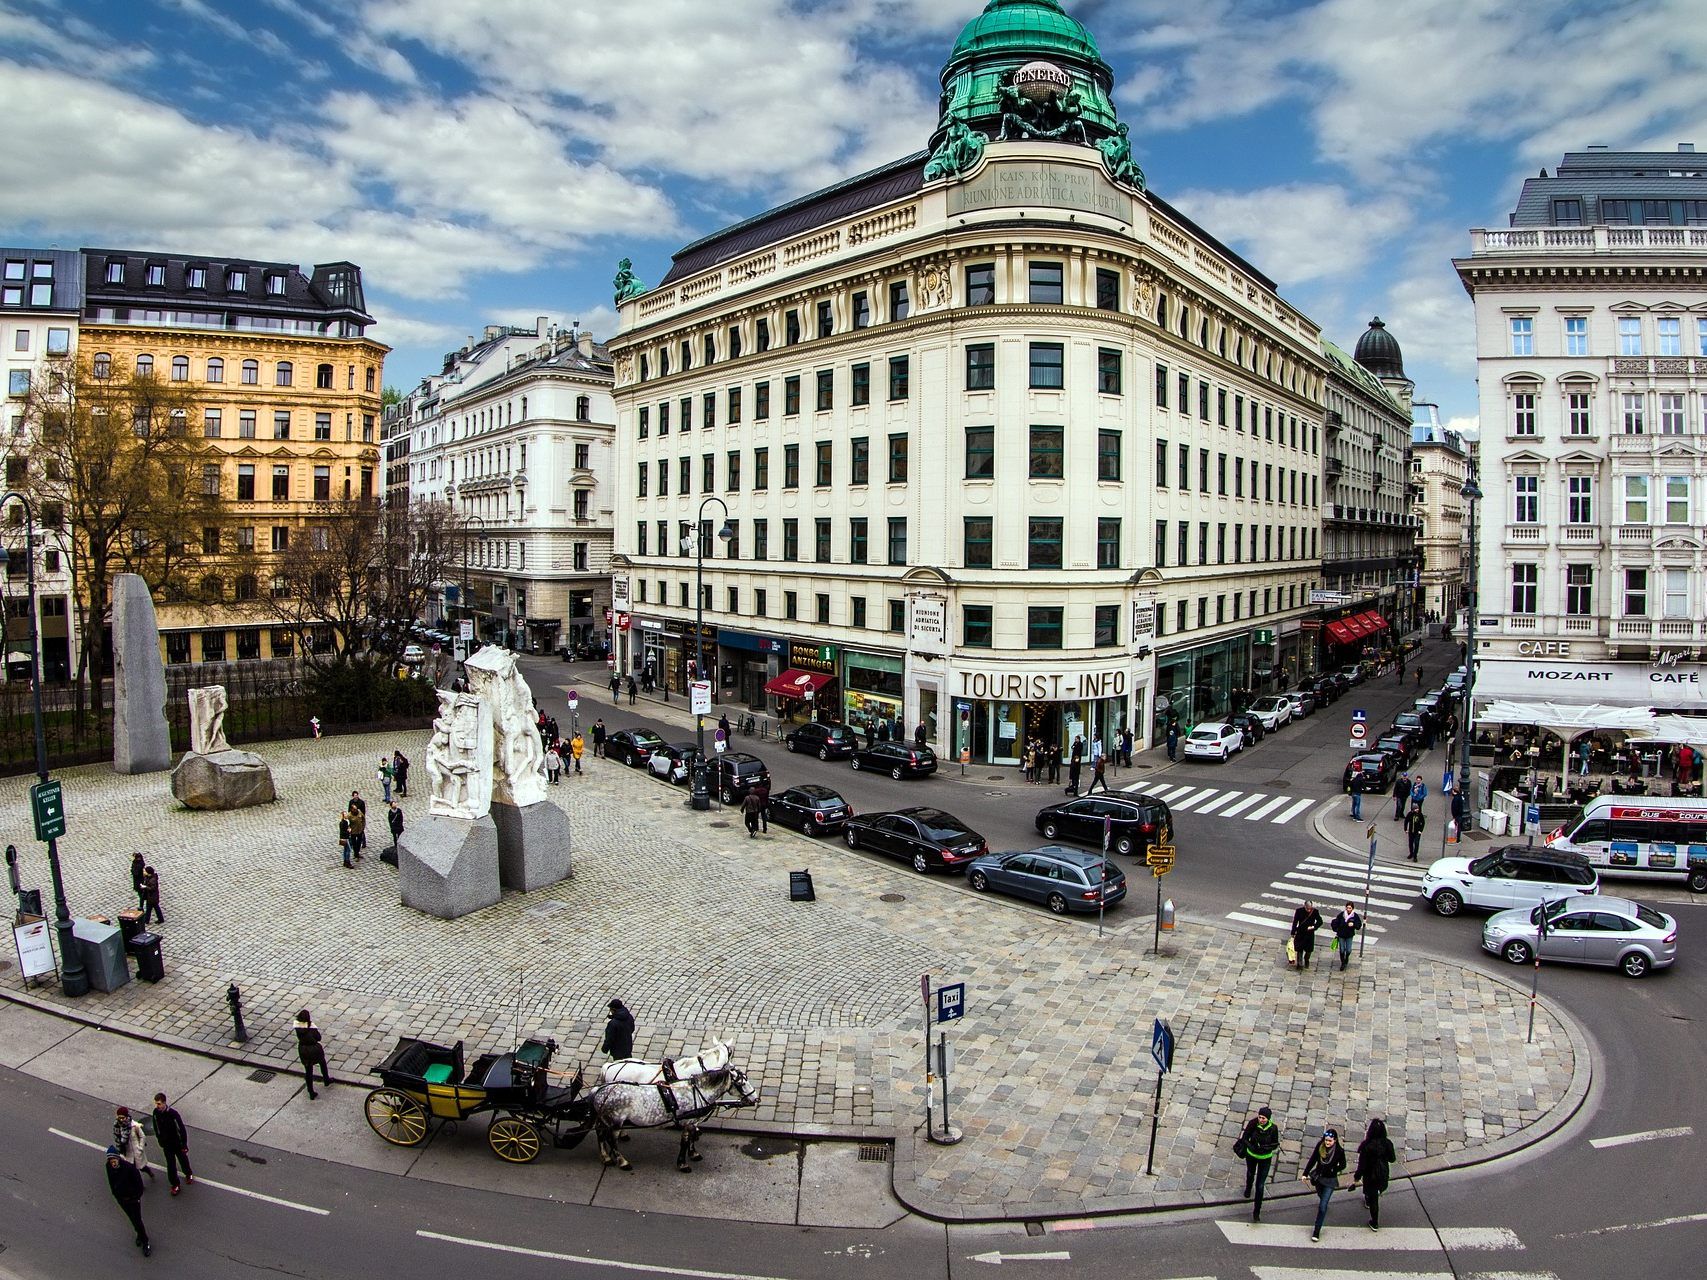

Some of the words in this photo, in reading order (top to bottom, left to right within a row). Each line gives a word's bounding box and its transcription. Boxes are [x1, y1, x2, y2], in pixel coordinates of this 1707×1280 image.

[963, 187, 1014, 206] RIUNIONE
[1017, 186, 1076, 202] ADRIATICA
[916, 609, 939, 617] RIUNIONE
[915, 617, 940, 625] ADRIATICA
[792, 646, 819, 657] BONBO
[1518, 642, 1570, 656] CAFE
[792, 656, 833, 670] ANZINGER
[1653, 646, 1690, 668] Mozart
[1528, 671, 1613, 681] MOZART
[1650, 672, 1699, 683] CAFÉ
[959, 670, 1125, 699] TOURIST-INFO
[944, 991, 959, 1004] Taxi
